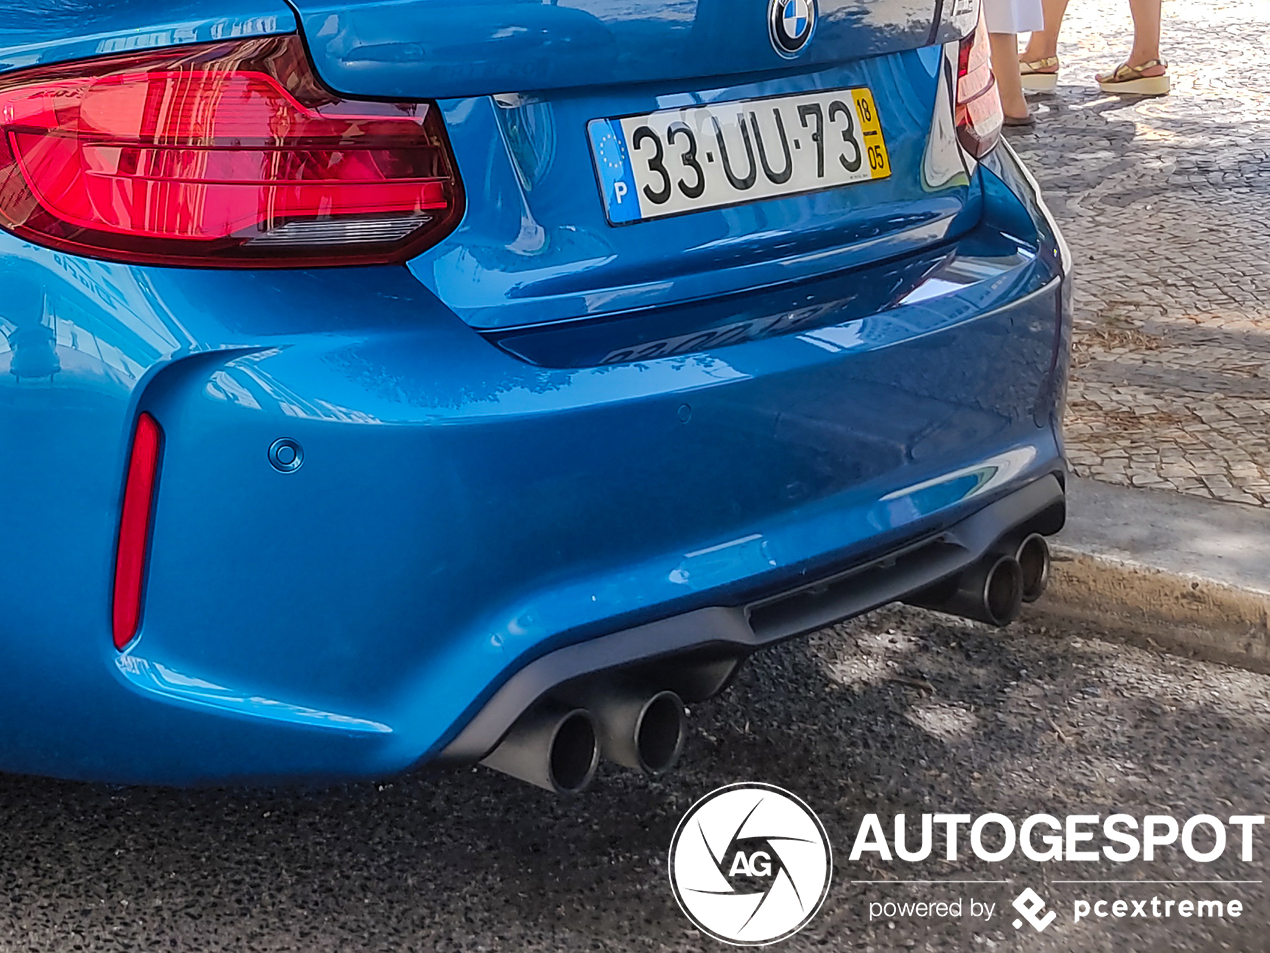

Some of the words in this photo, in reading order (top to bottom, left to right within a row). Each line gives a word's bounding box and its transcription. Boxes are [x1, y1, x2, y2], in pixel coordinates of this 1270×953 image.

[857, 98, 871, 123] 18
[867, 145, 884, 170] 05
[614, 181, 628, 204] P
